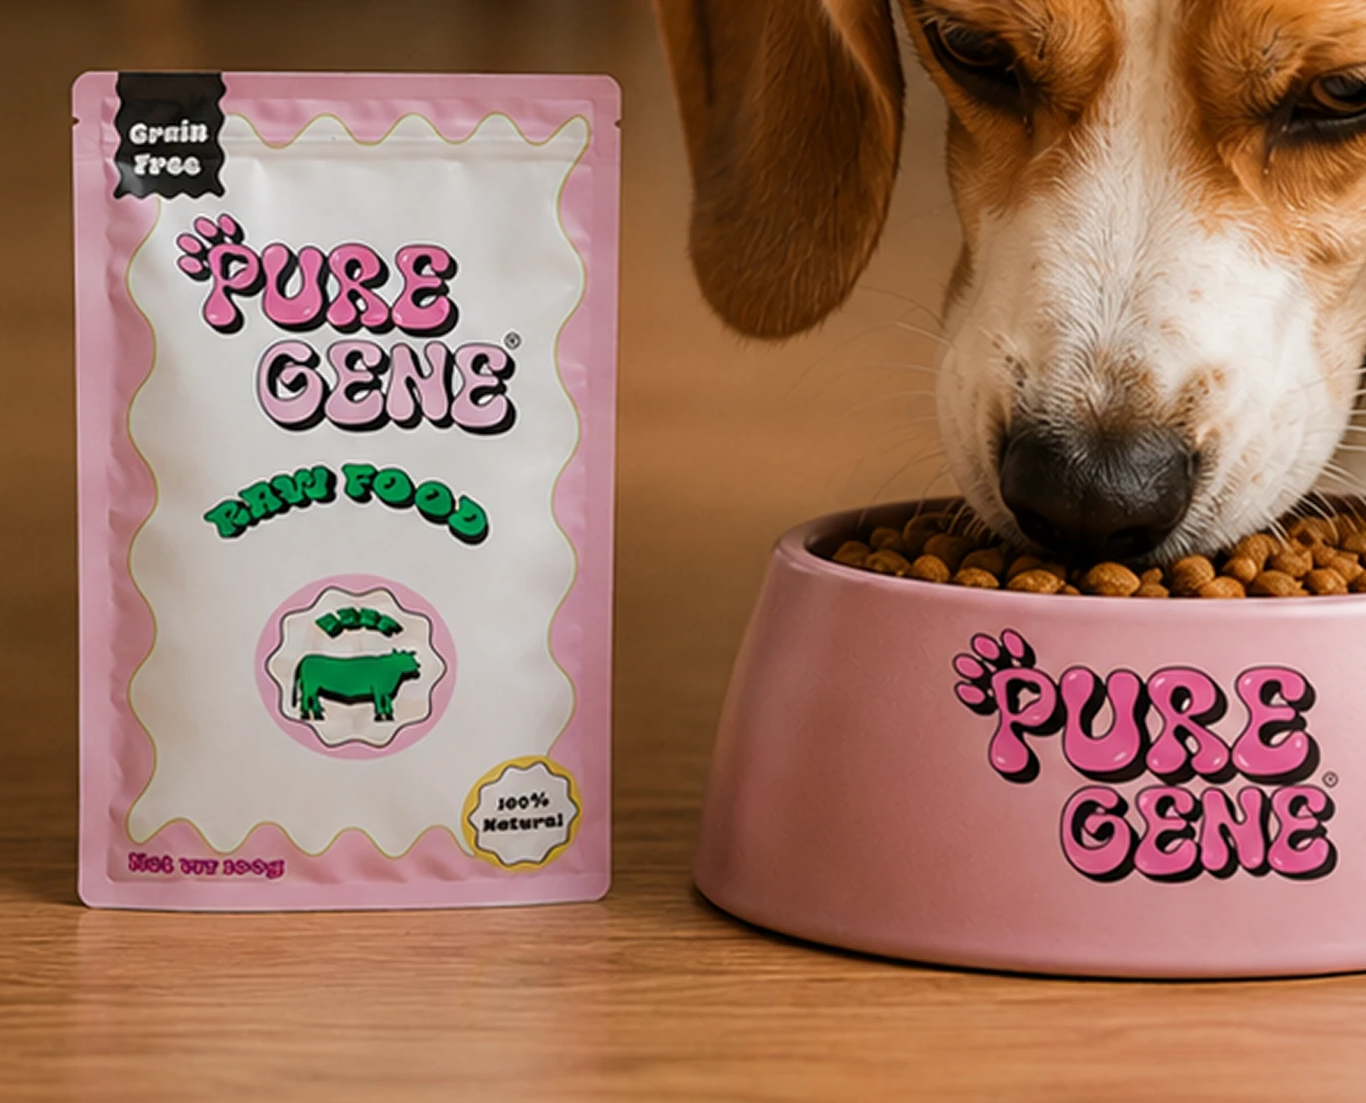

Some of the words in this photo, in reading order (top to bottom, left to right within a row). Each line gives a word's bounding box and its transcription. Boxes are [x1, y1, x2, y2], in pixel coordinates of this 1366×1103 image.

[129, 119, 209, 145] Grain
[134, 153, 201, 175] Free
[202, 242, 458, 335] PURE
[257, 339, 517, 436] GENE
[203, 465, 337, 539] RAW
[341, 463, 490, 545] FOOD
[988, 665, 1321, 785] PURE
[483, 813, 563, 832] Natural
[498, 792, 549, 811] 100%
[1060, 785, 1338, 883] GENE
